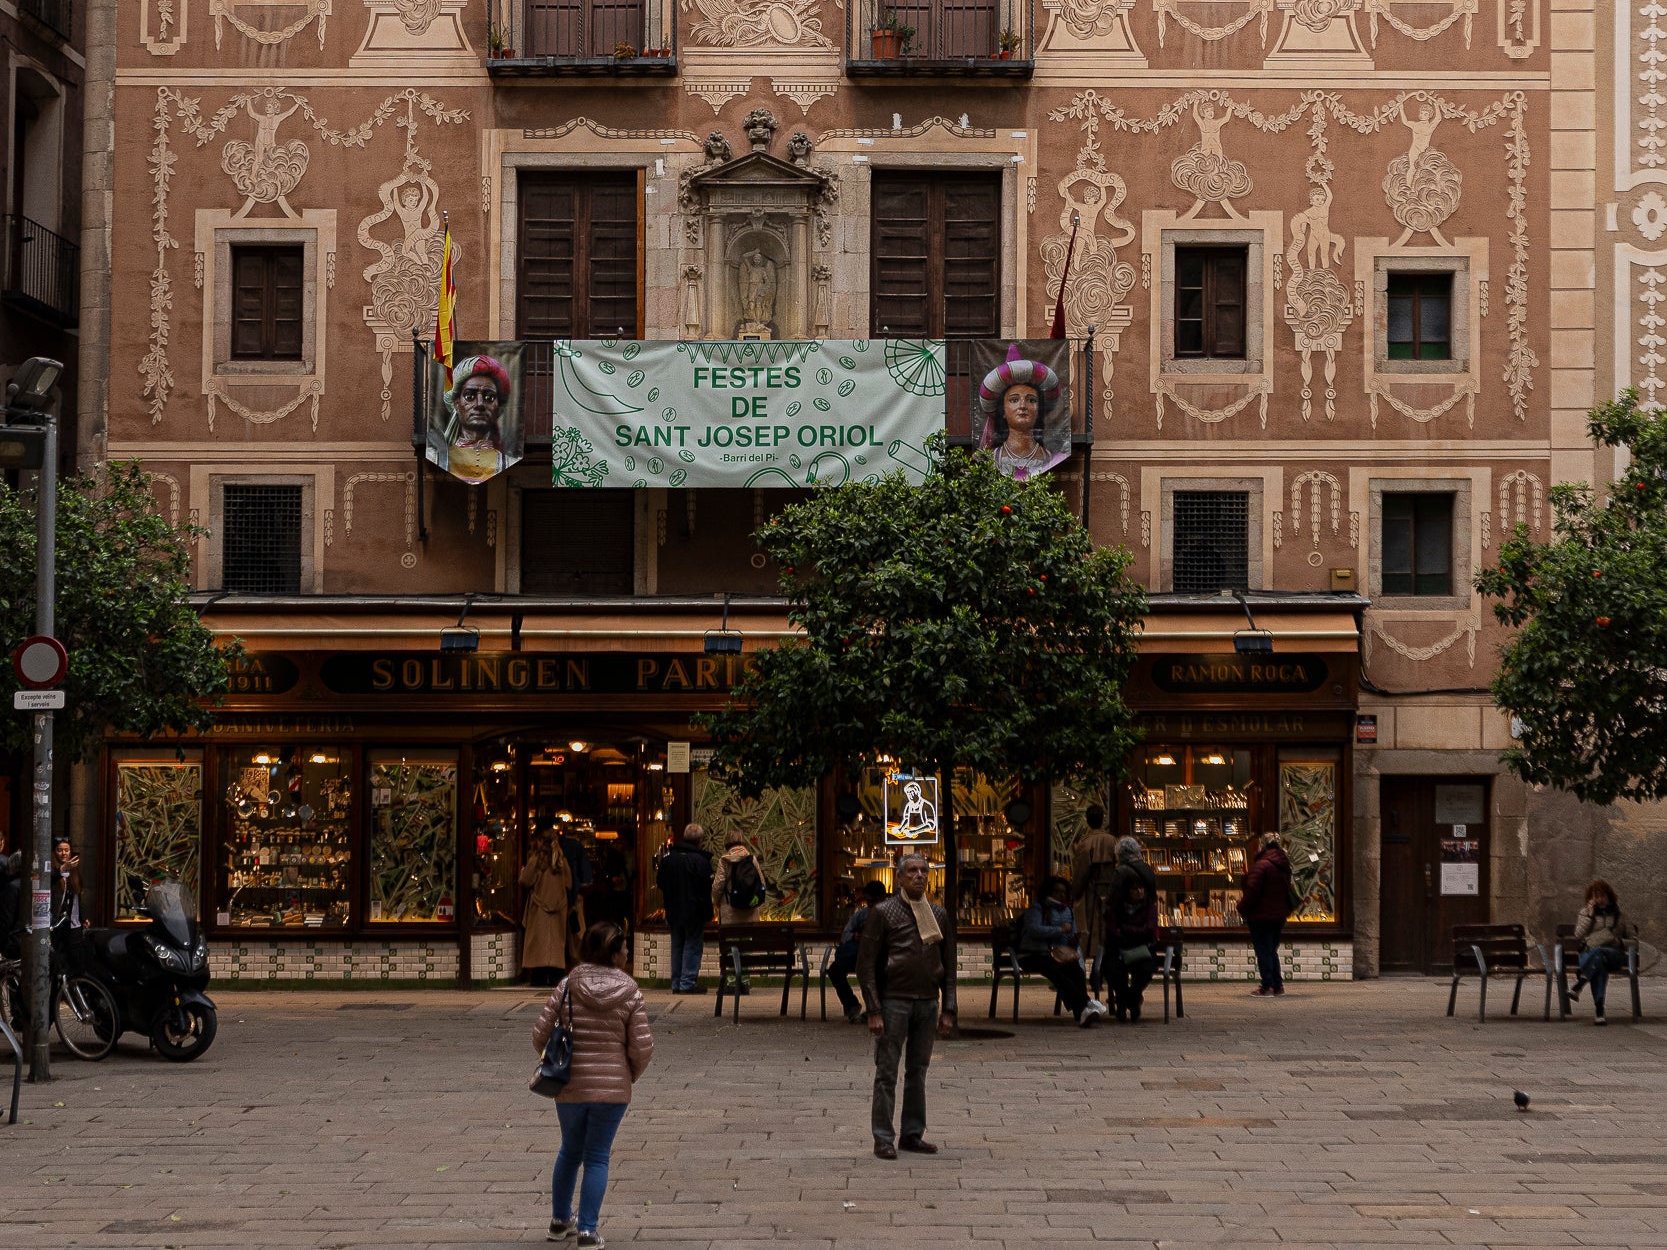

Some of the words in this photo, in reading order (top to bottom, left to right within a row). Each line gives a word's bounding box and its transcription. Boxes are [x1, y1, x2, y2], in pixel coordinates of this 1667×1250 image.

[1067, 169, 1115, 185] ANGELUS
[693, 366, 802, 389] FESTES
[731, 396, 768, 418] DE
[615, 425, 691, 447] SANT
[697, 425, 790, 447] JOSEP
[797, 425, 883, 447] ORIOL
[719, 453, 747, 462] -Barri
[748, 453, 764, 462] del
[372, 658, 590, 690] SOLINGEN
[1171, 663, 1243, 683] RAMON
[1251, 663, 1309, 683] ROCA
